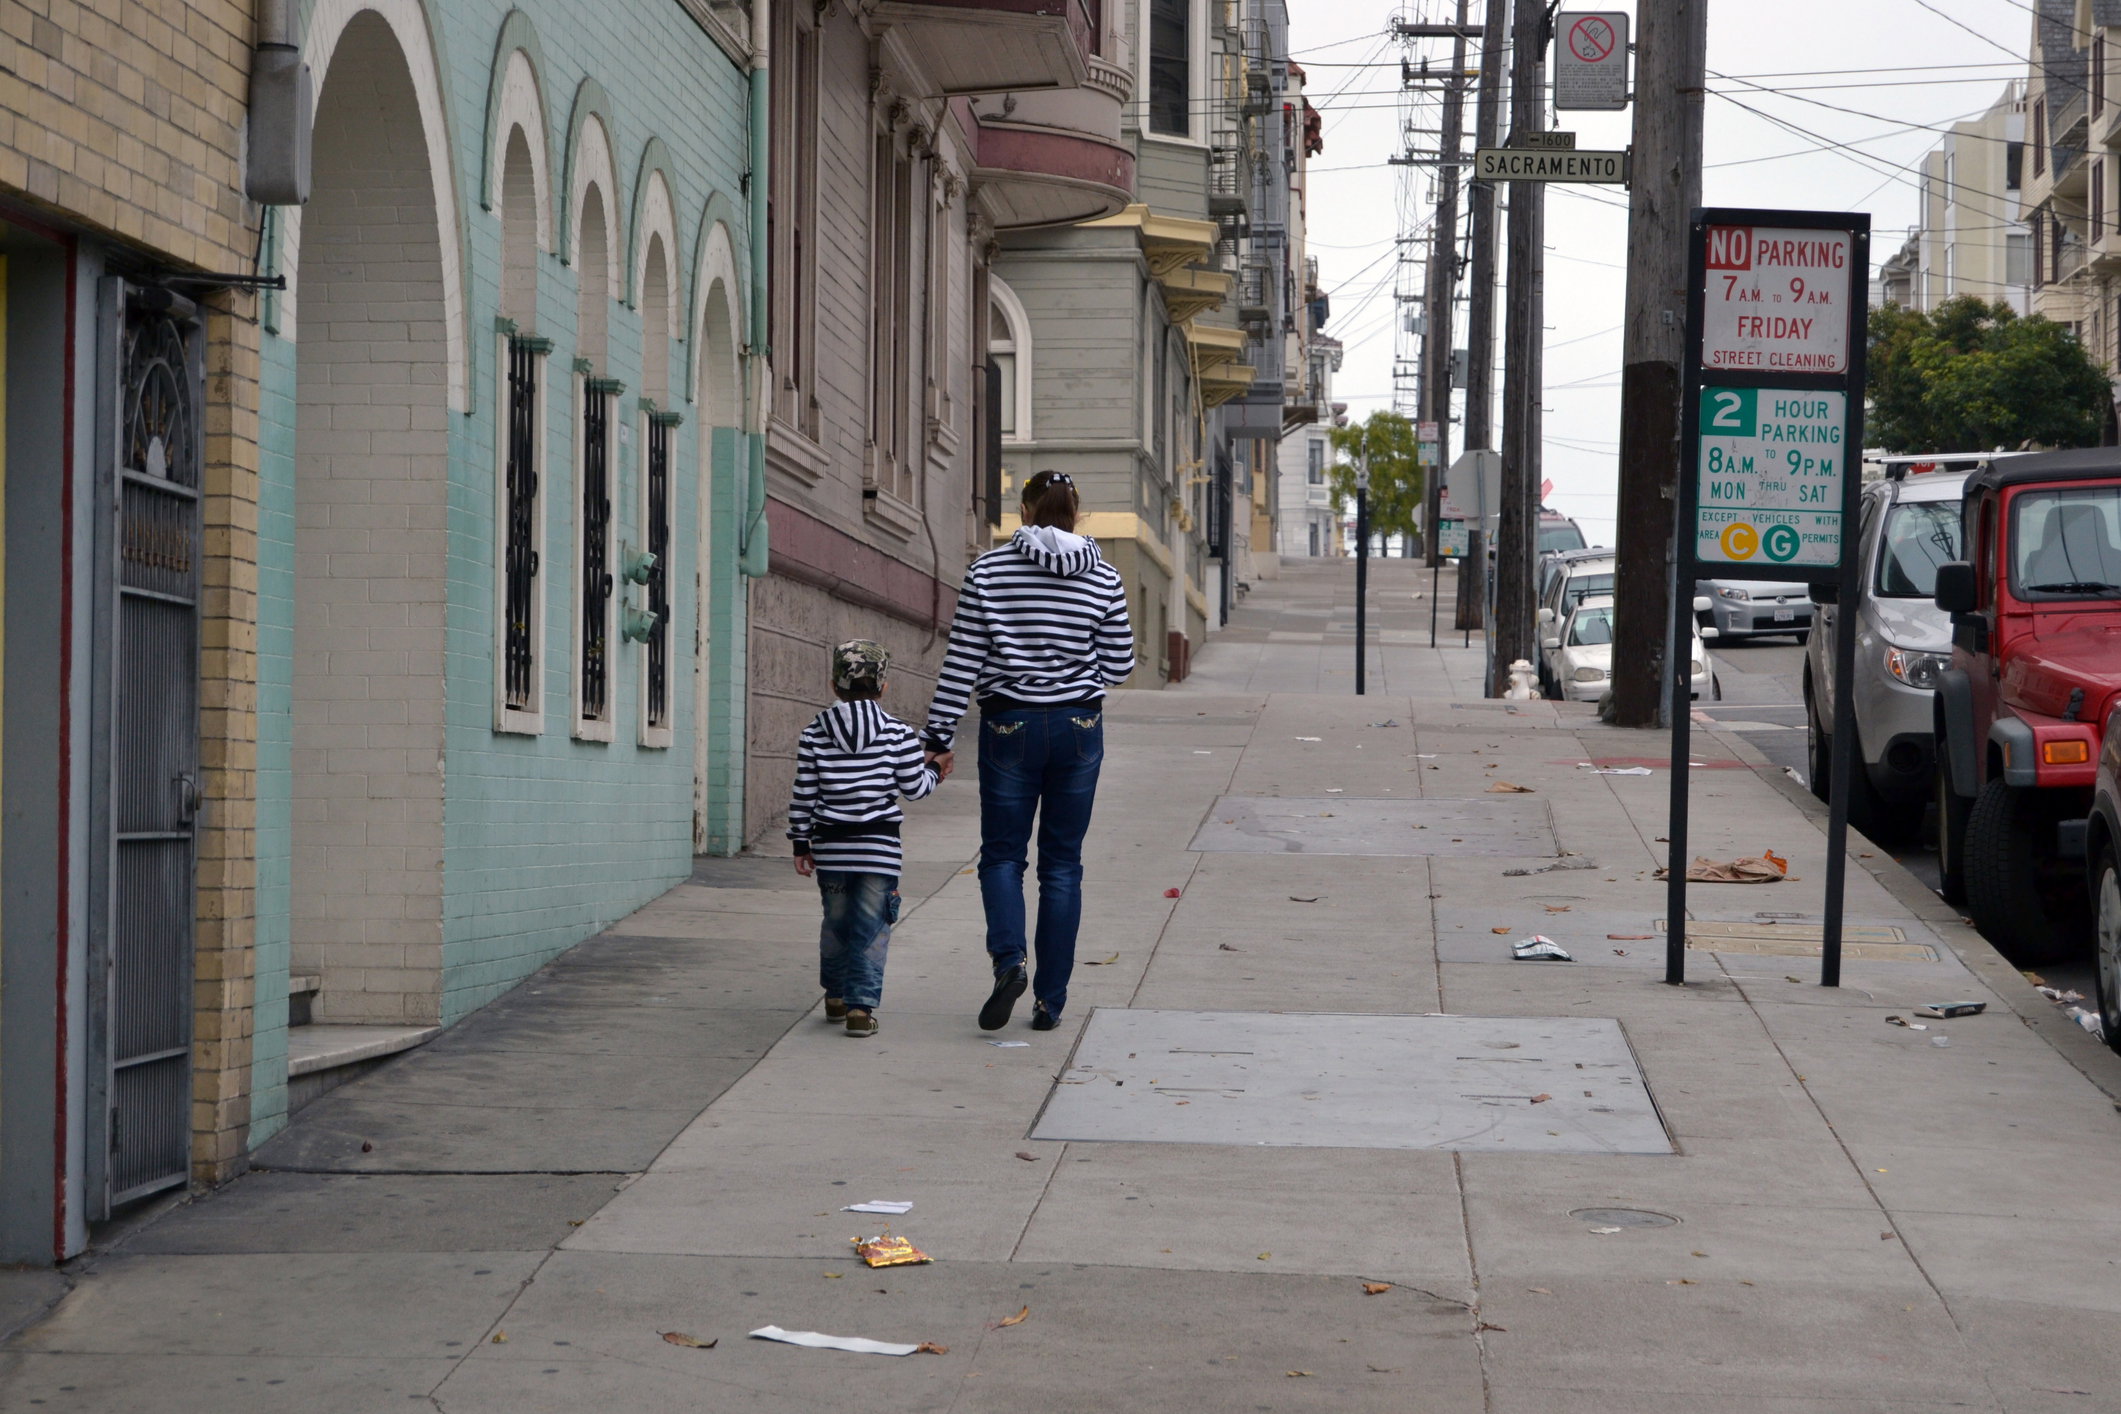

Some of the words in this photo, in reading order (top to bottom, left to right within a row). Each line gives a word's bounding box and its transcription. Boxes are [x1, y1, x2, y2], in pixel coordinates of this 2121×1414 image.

[1542, 134, 1571, 146] 1600
[1485, 155, 1615, 176] SACRAMENTO
[1710, 229, 1747, 266] NO
[1758, 240, 1844, 268] PARKING
[1773, 294, 1781, 302] TO
[1738, 316, 1813, 339] FRIDAY
[1713, 351, 1762, 365] STREET
[1770, 352, 1835, 368] CLEANING
[1712, 392, 1741, 427] 2
[1775, 400, 1828, 419] HOUR
[1762, 424, 1840, 443] PARKING
[1765, 450, 1775, 458] TO
[1711, 482, 1745, 499] MON
[1759, 481, 1787, 491] THRU
[1800, 485, 1827, 502] SAT
[1702, 512, 1738, 521] EXCEPT
[1753, 514, 1800, 524] VEHICLES
[1815, 516, 1838, 525] WITH
[1700, 530, 1719, 540] AREA
[1729, 528, 1749, 554] C
[1771, 530, 1791, 556] G
[1802, 533, 1839, 544] PERMITS
